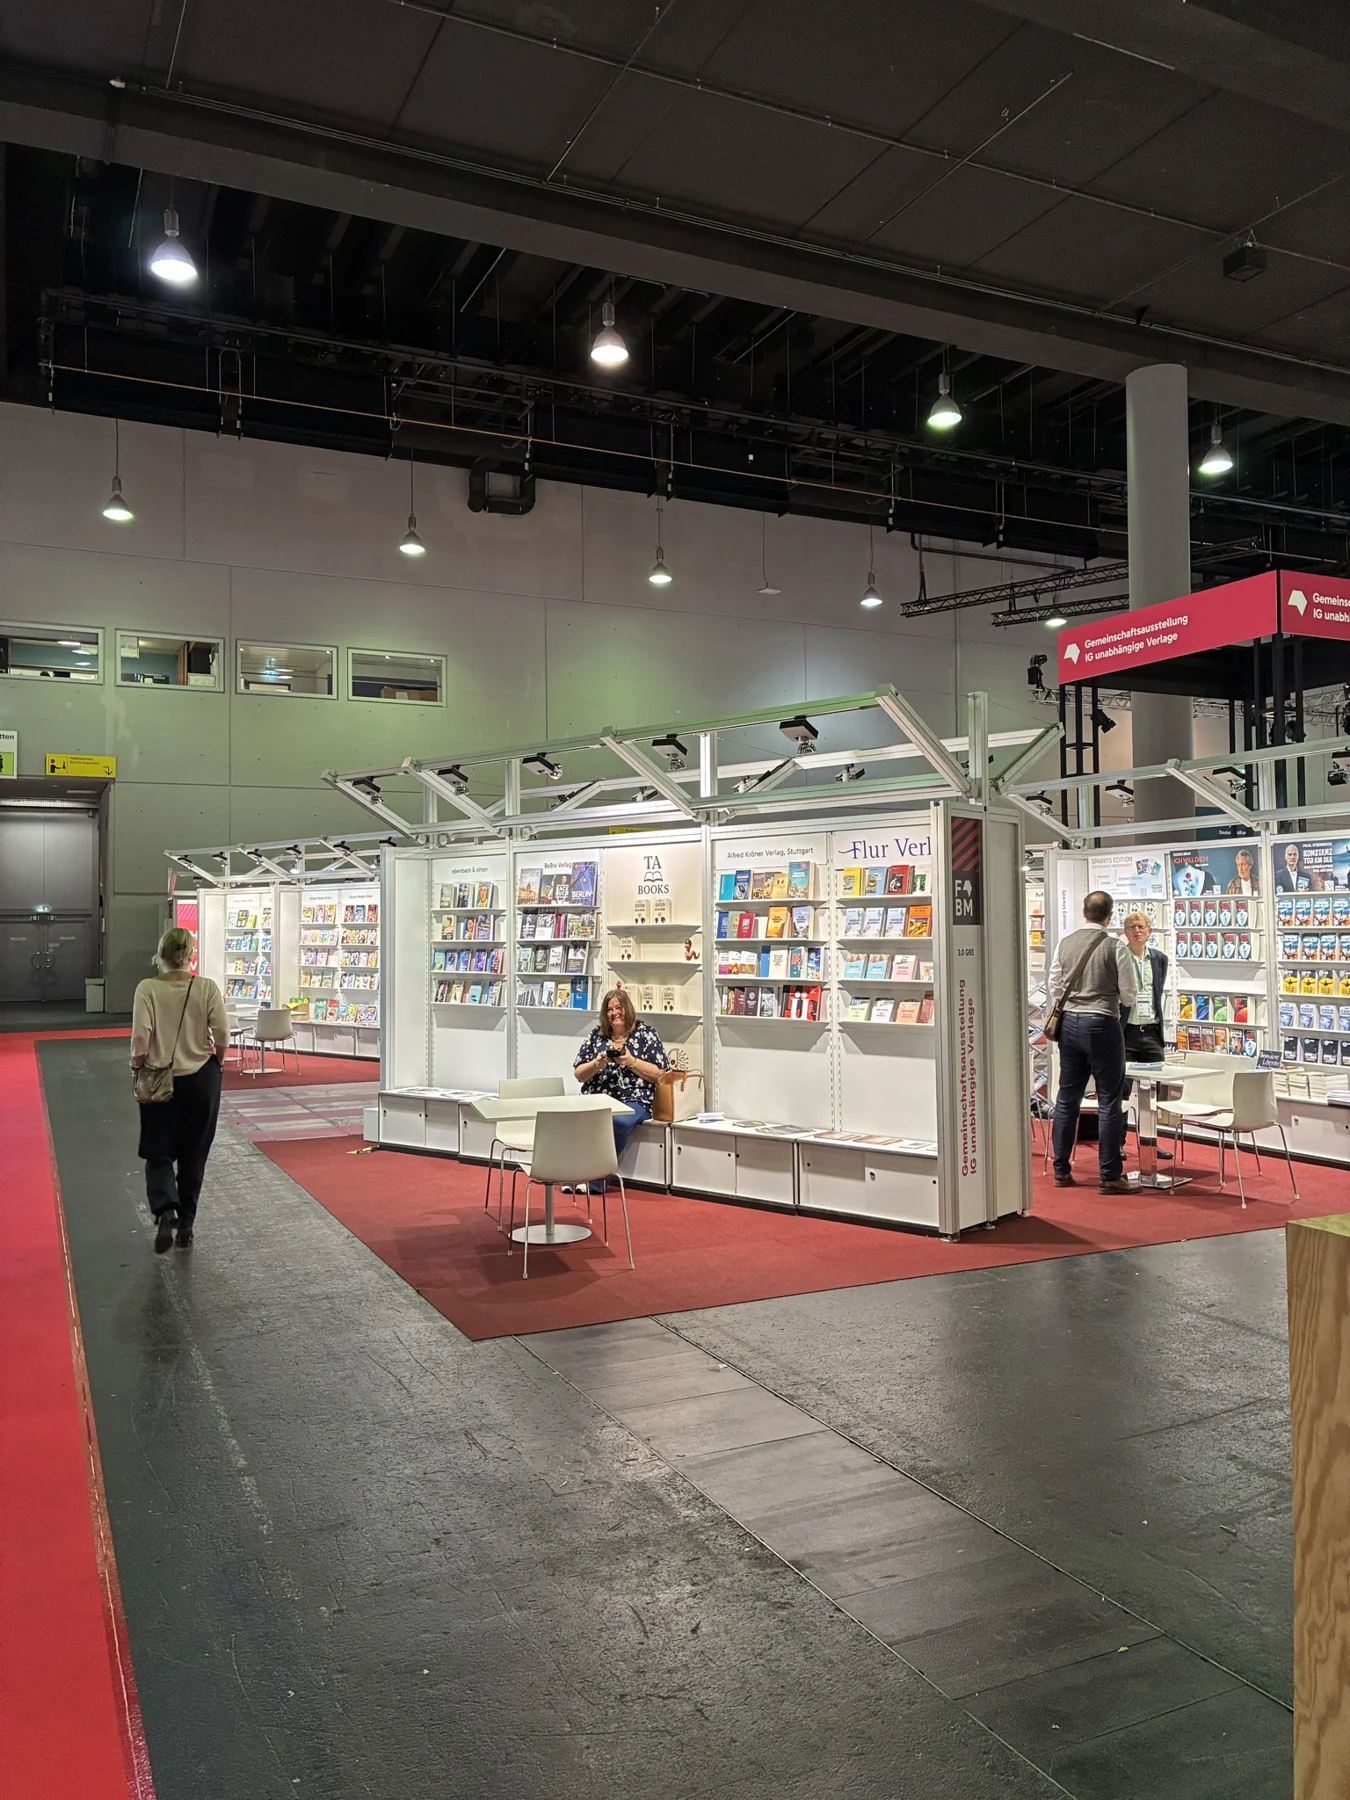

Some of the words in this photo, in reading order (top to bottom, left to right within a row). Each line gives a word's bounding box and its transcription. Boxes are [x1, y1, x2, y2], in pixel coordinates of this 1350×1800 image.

[1313, 607, 1323, 619] IG
[1324, 611, 1350, 622] unabh
[1084, 615, 1188, 649] Gemeinschaftsausstellung
[1085, 652, 1094, 663] IG
[1095, 641, 1145, 660] unabhängige
[1146, 632, 1179, 648] Verlage
[745, 850, 764, 858] Kröner
[765, 849, 786, 857] Verlag,
[787, 847, 814, 855] Stuttgart
[838, 840, 889, 859] Flur
[893, 836, 932, 857] Verl
[1303, 849, 1333, 857] KONSTANZ
[644, 856, 662, 869] TA
[1091, 857, 1113, 865] SPARKYS
[571, 890, 592, 898] BERLIN
[638, 884, 669, 895] BOOKS
[955, 899, 973, 916] BM
[959, 979, 968, 1176] Gemeinschaftsausstellung
[968, 1059, 977, 1154] unabhängige
[970, 1159, 977, 1174] IG
